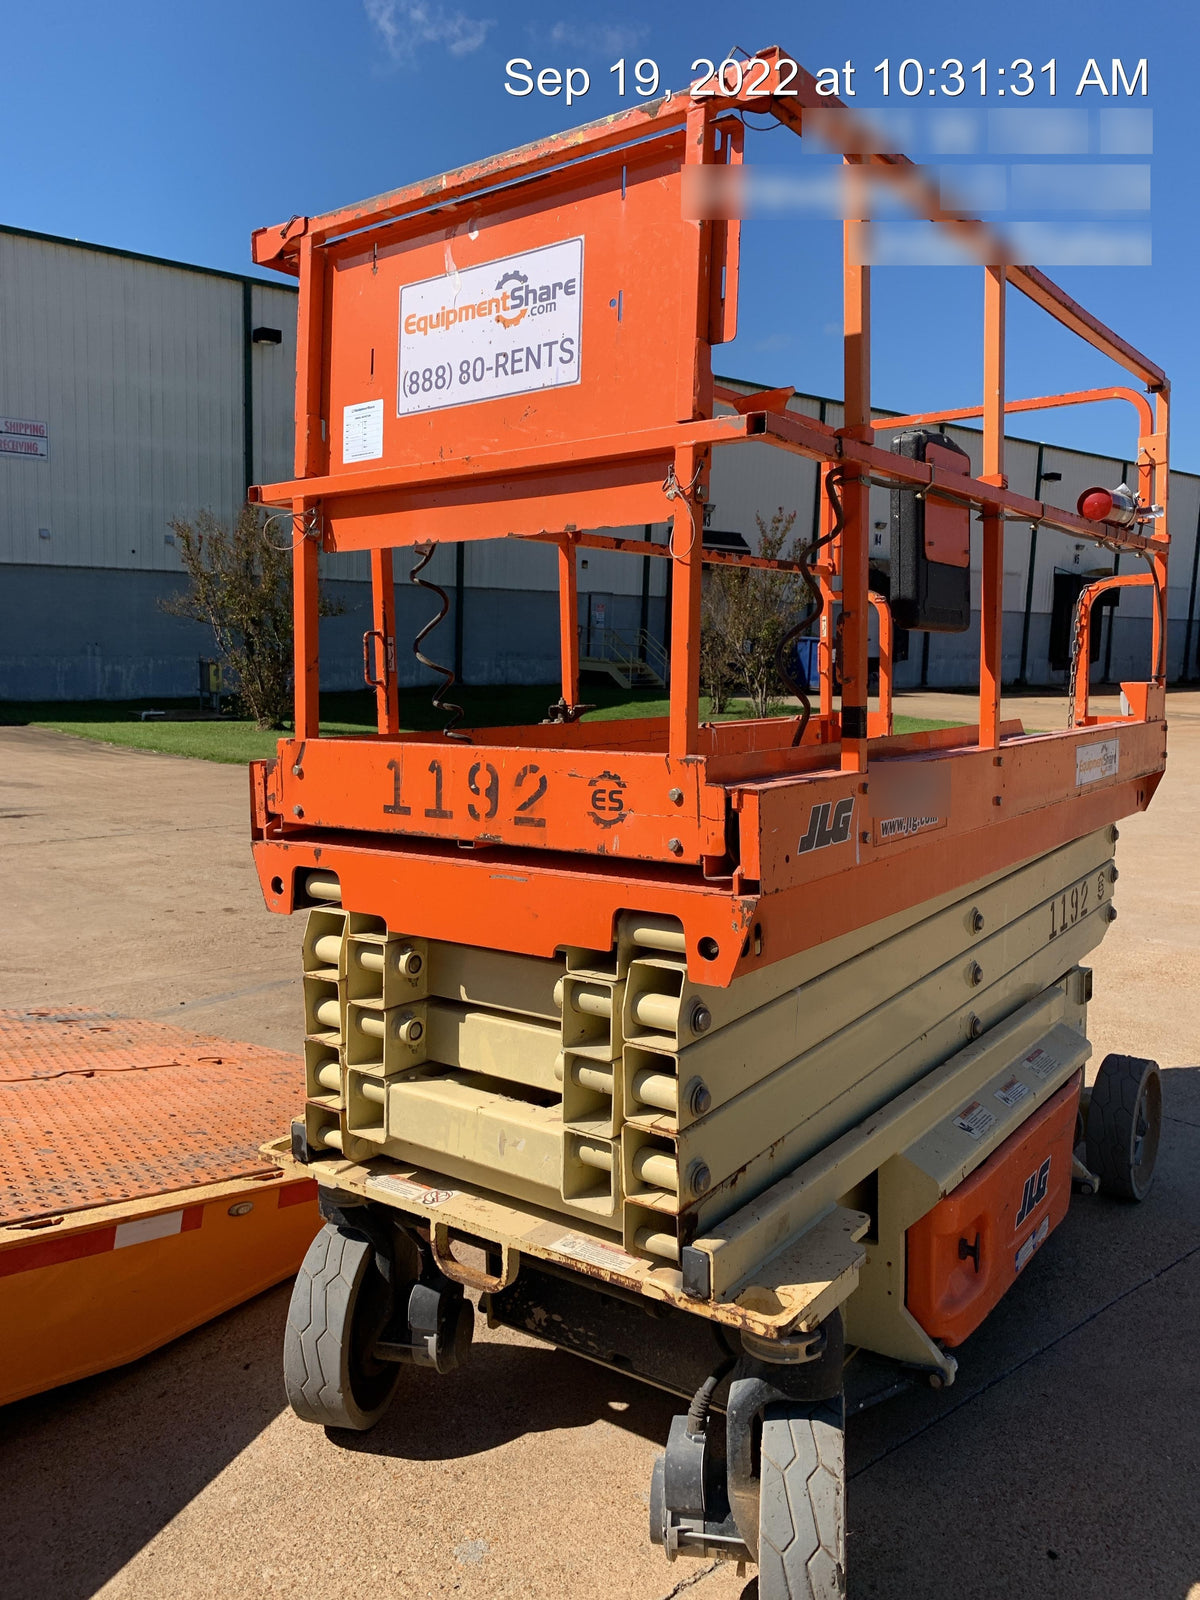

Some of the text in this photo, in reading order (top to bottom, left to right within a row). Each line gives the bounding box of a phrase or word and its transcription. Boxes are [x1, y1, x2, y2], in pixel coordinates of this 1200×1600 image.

[403, 277, 577, 336] EquipmentShare
[527, 301, 558, 318] .com
[402, 337, 575, 398] (888) 80-RENTS
[4, 421, 45, 435] SHIPPING
[382, 758, 548, 829] 1192
[591, 788, 624, 812] ES
[797, 796, 855, 856] JLG
[1048, 880, 1089, 941] 1192
[1014, 1154, 1051, 1232] JLG
